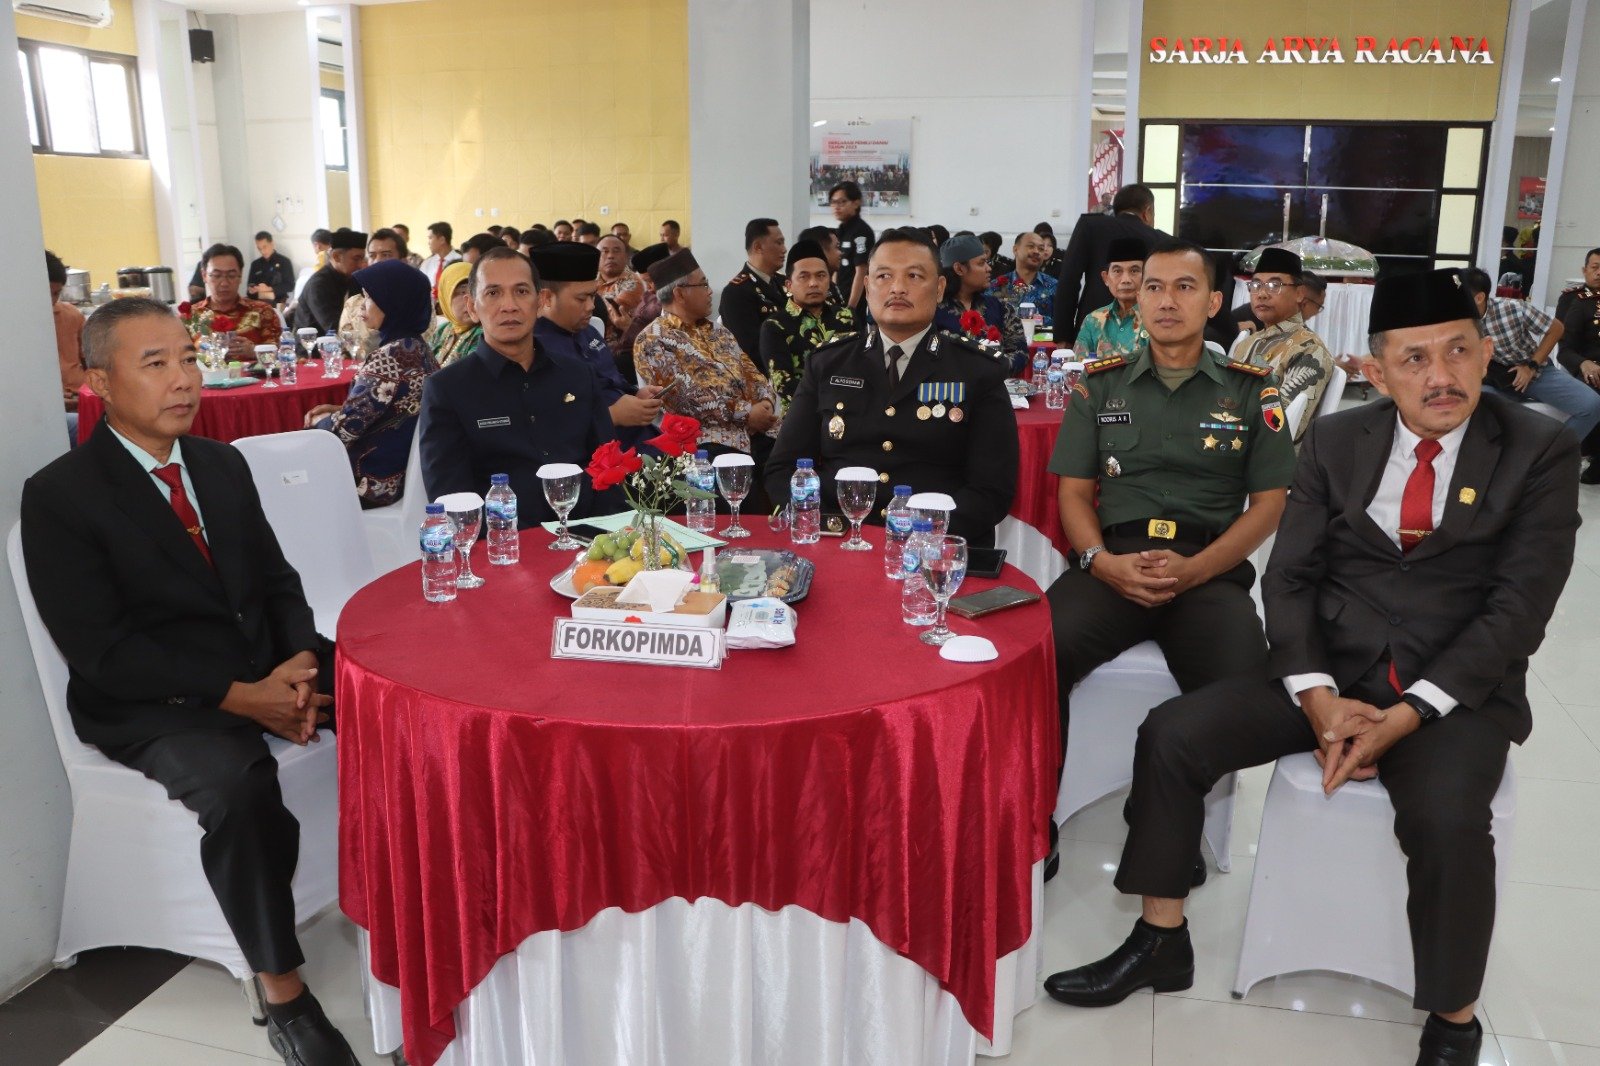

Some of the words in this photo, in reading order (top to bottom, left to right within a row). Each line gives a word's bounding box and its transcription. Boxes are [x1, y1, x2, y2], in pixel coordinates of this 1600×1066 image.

[1149, 36, 1249, 64] SARJA
[1256, 36, 1345, 64] ARYA
[1354, 36, 1494, 64] RACANA
[564, 627, 704, 657] FORKOPIMDA
